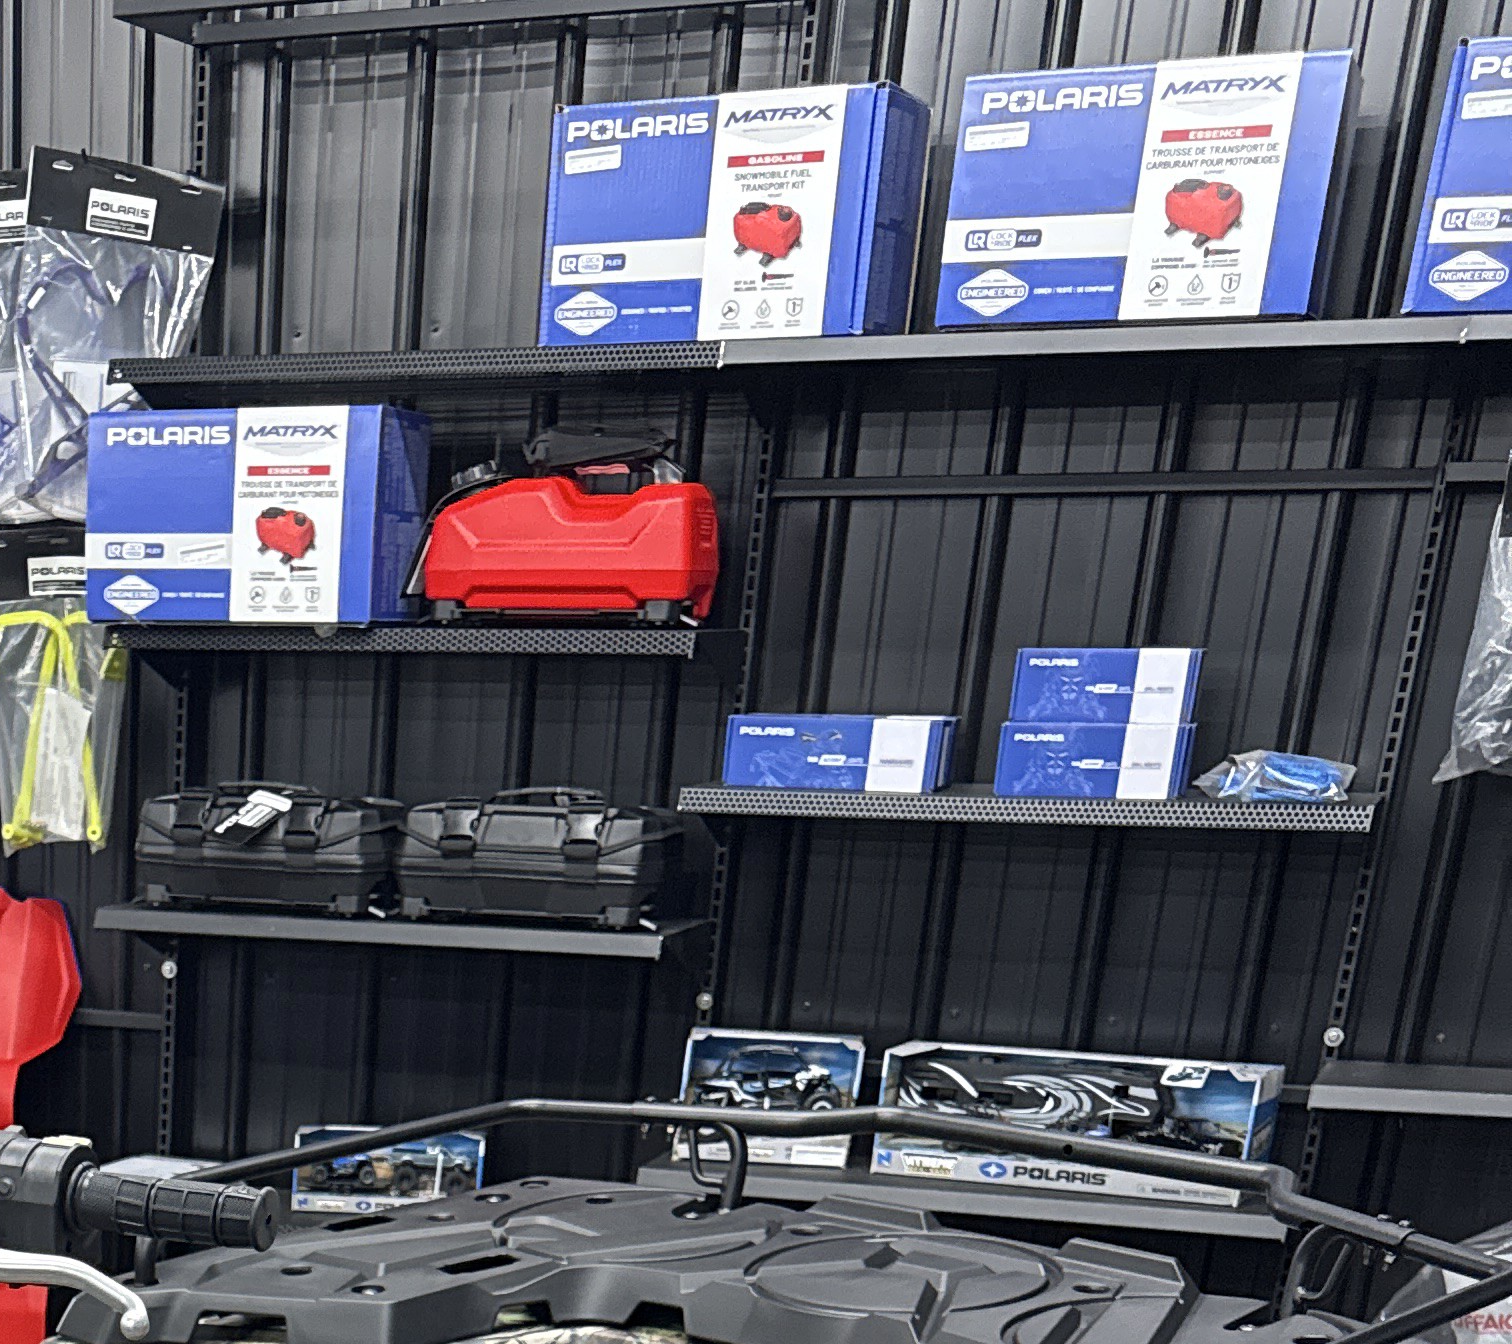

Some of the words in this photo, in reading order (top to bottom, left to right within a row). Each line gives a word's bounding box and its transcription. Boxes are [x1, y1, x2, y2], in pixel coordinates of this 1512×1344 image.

[1160, 75, 1287, 100] MATRYX
[982, 83, 1144, 115] POLARIS
[723, 104, 834, 128] MATRYX
[566, 112, 709, 142] POLARIS
[1152, 147, 1193, 157] TROUSSE
[1195, 146, 1207, 155] DE
[1209, 143, 1265, 154] TRANSPORT
[1266, 142, 1280, 151] DE
[748, 153, 803, 165] GASOLINE
[1200, 158, 1224, 167] POUR
[734, 170, 789, 181] SNOWMOBILE
[791, 168, 812, 178] FUEL
[741, 181, 789, 192] TRANSPORT
[791, 180, 805, 190] KIT
[91, 201, 150, 219] POLARIS
[1433, 269, 1506, 281] ENGINEERED
[961, 287, 1026, 298] ENGINEERED
[107, 425, 230, 446] POLARIS
[243, 425, 338, 440] MATRYX
[1029, 658, 1079, 667] POLARIS
[739, 725, 795, 737] POLARIS
[1014, 733, 1065, 742] POLARIS
[1013, 1166, 1107, 1186] POLARIS
